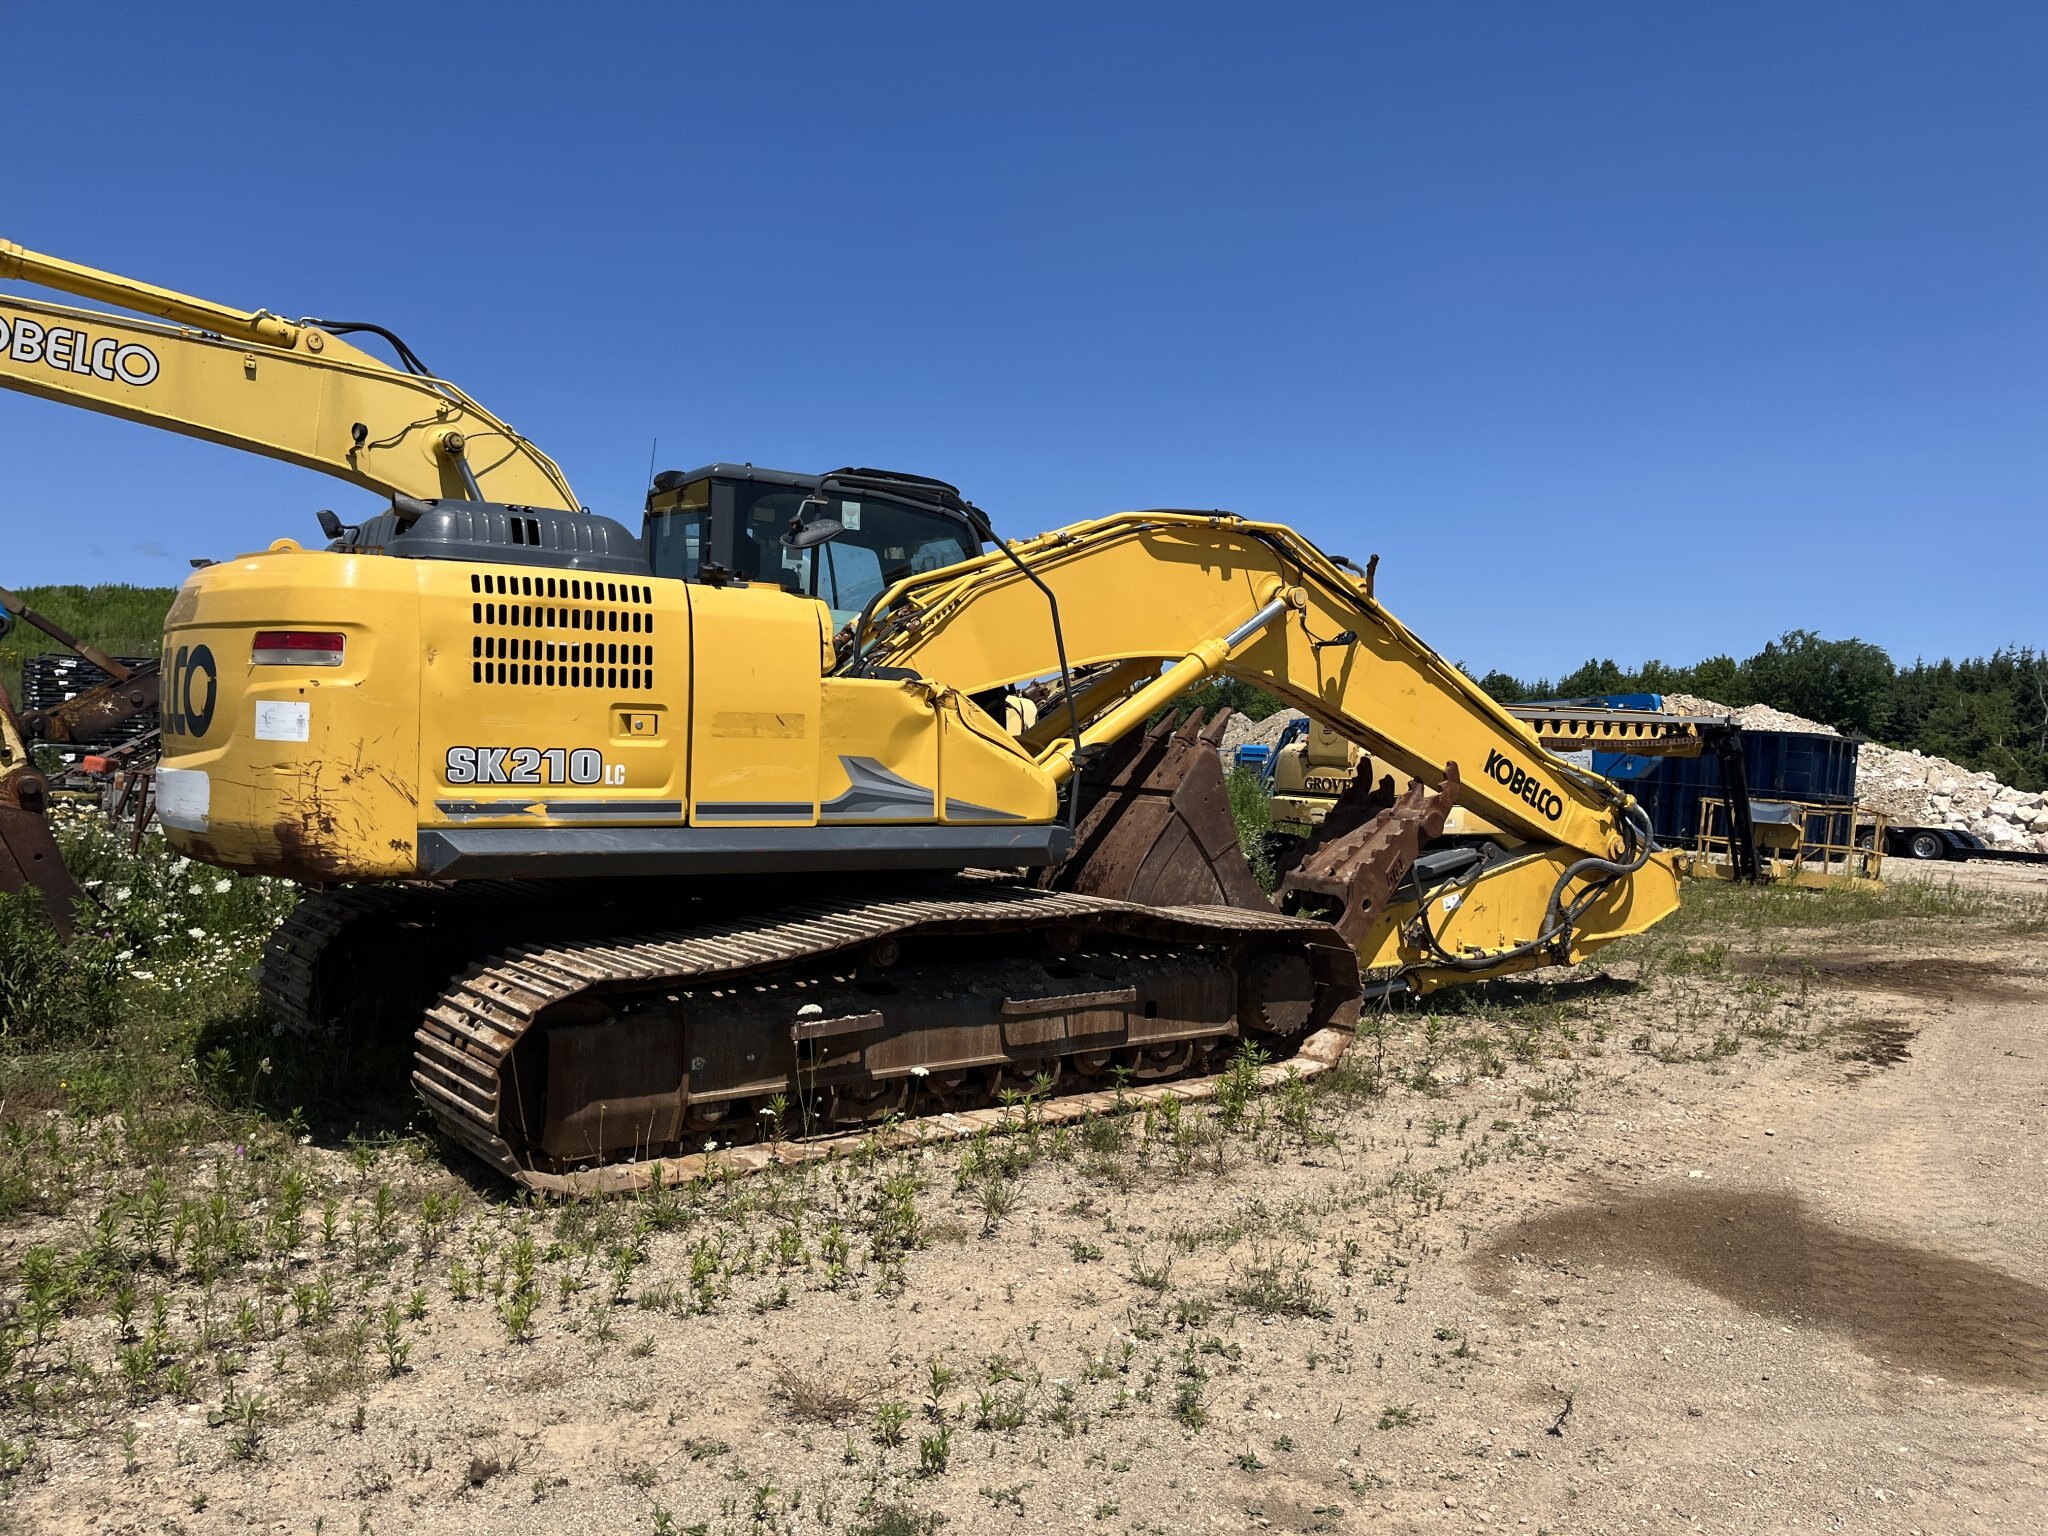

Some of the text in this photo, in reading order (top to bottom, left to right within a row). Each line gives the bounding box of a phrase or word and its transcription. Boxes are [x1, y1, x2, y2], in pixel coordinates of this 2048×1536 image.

[0, 315, 160, 386] BELCO
[446, 746, 626, 785] SK210 LC
[1483, 747, 1563, 821] KOBELCO
